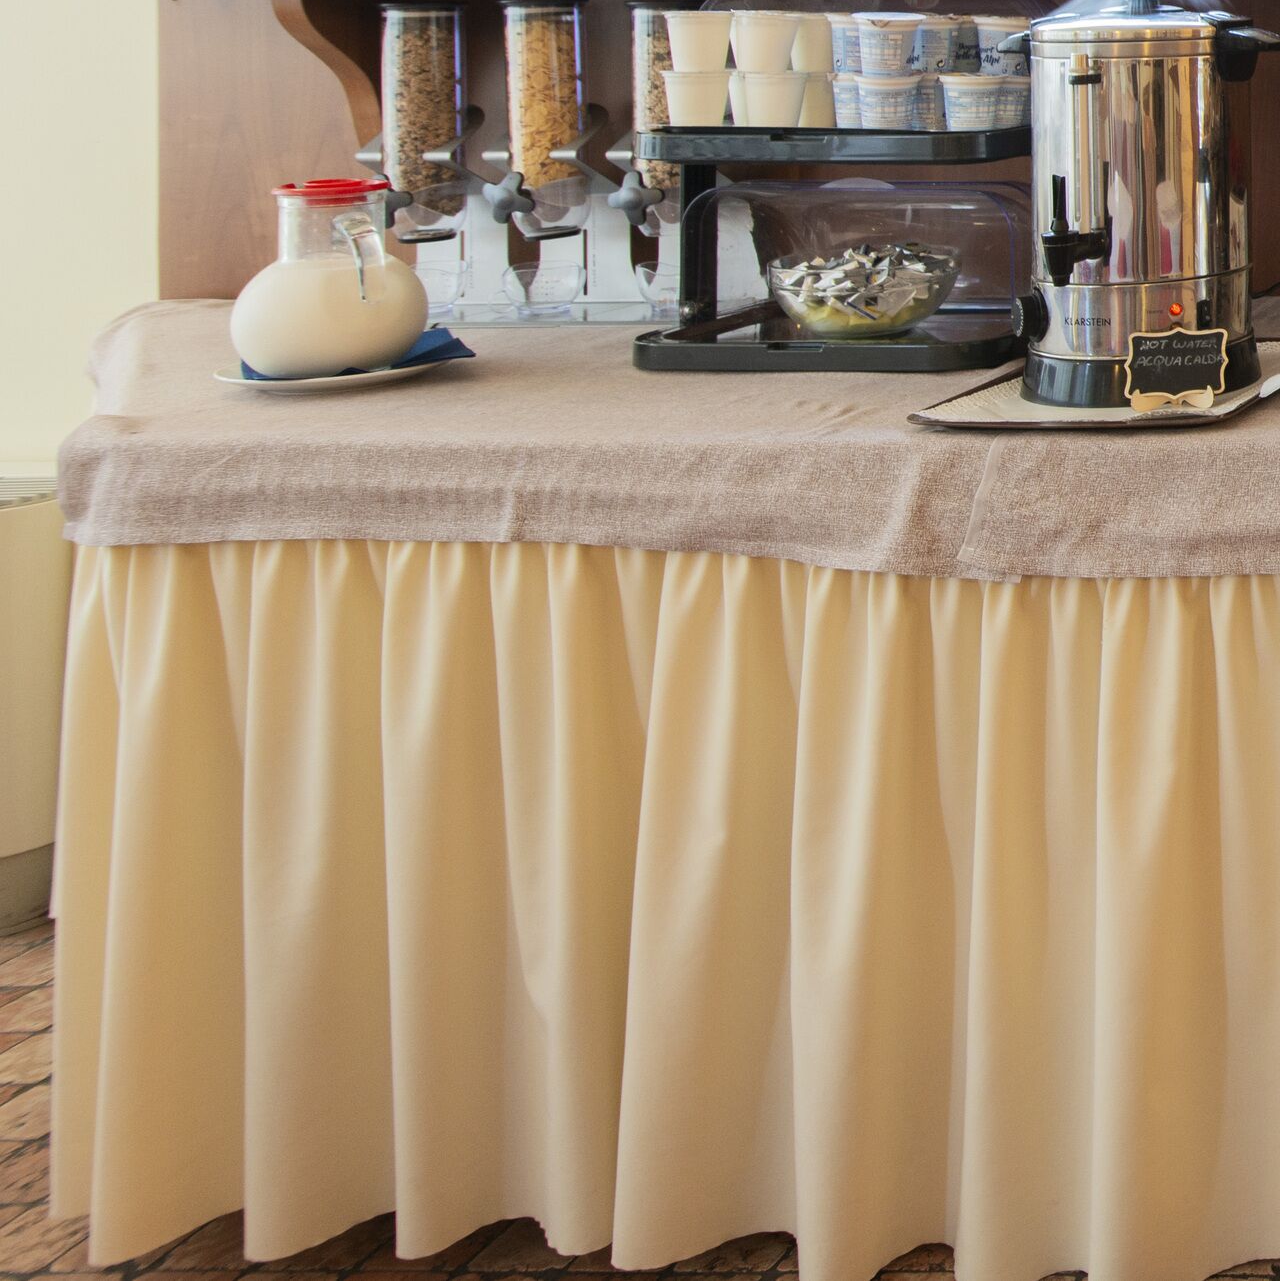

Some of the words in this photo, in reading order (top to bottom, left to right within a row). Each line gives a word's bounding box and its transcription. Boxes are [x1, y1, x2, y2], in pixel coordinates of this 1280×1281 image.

[1064, 317, 1111, 327] KLARSTEIN
[1140, 339, 1169, 351] HOT
[1172, 338, 1218, 350] WATER
[1136, 355, 1182, 369] ACQUA
[1184, 354, 1224, 366] CALDA
